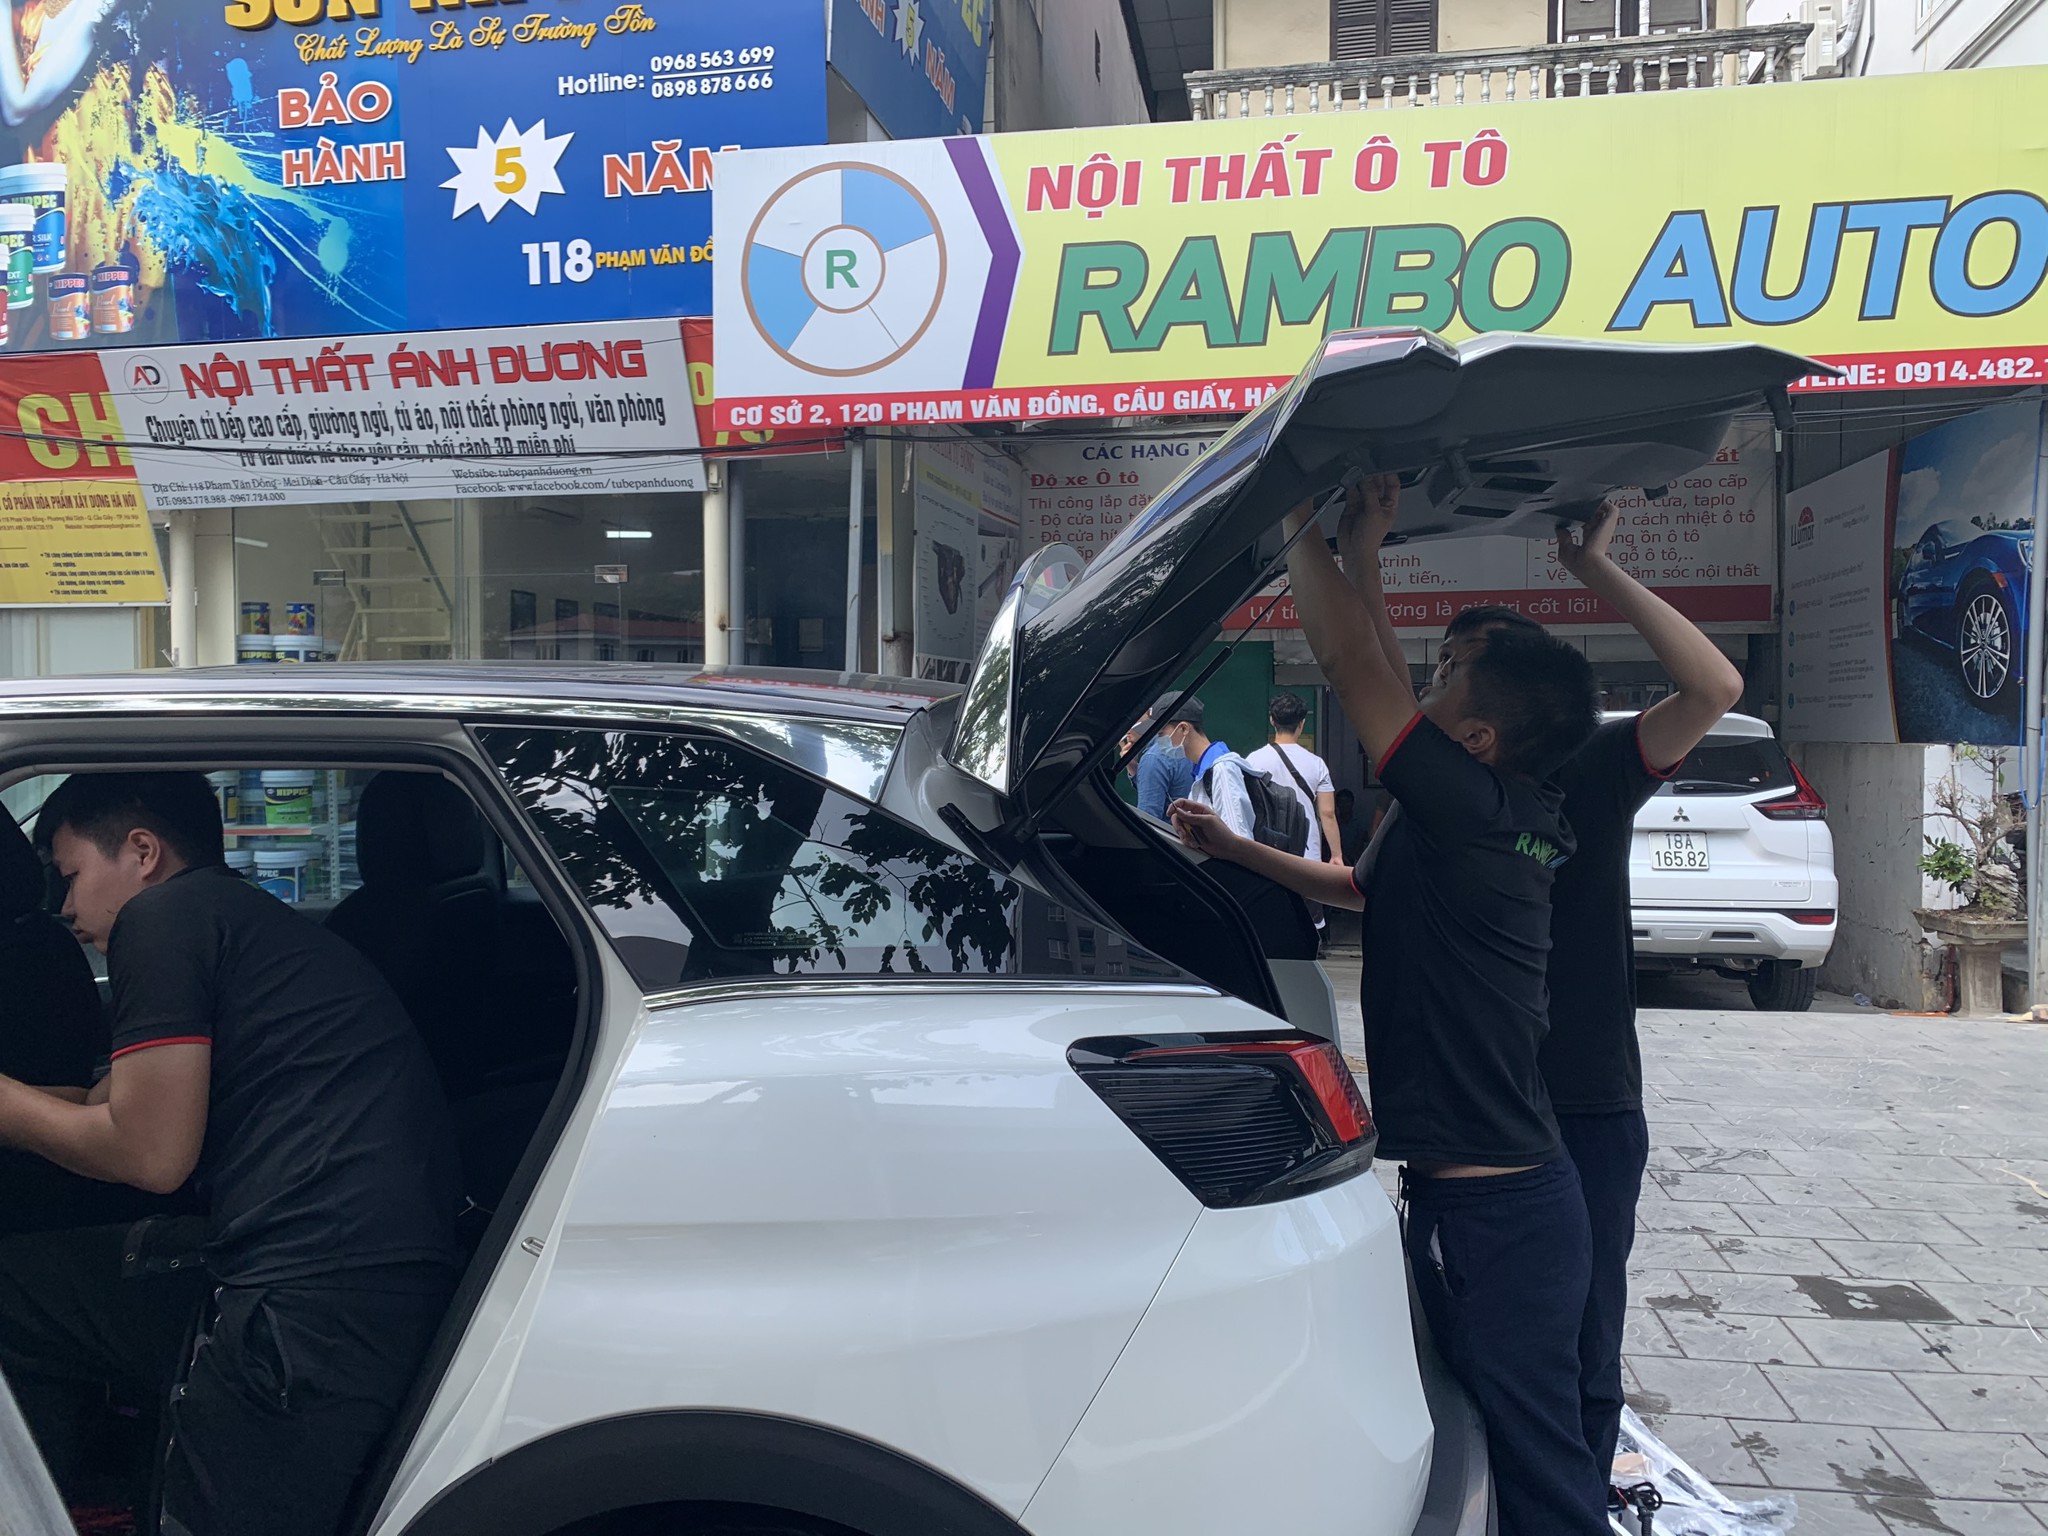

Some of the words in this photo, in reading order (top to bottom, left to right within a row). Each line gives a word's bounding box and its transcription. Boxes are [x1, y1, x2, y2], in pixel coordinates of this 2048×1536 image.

[294, 33, 348, 65] Chất
[355, 27, 423, 64] Lượng
[429, 20, 464, 51] Là
[469, 16, 508, 50] Sự
[512, 12, 598, 49] Trường
[604, 3, 656, 34] Tồn
[905, 3, 915, 48] 5
[650, 53, 696, 73] 0968
[700, 49, 734, 68] 563
[738, 45, 775, 65] 699
[558, 73, 646, 96] Hotline:
[651, 79, 697, 99] 0898
[700, 76, 732, 95] 878
[735, 72, 774, 91] 666
[925, 38, 955, 115] NĂM
[278, 71, 392, 129] BẢO
[281, 136, 405, 187] HÀNH
[493, 147, 527, 194] 5
[1025, 152, 1143, 219] NỘI
[1164, 133, 1331, 205] THẤT
[1353, 134, 1399, 193] Ô
[1422, 127, 1509, 191] TÔ
[522, 238, 595, 286] 118
[596, 250, 646, 271] PHẠM
[650, 244, 686, 265] VĂN
[826, 249, 859, 289] R
[1047, 215, 1573, 357] RAMBO
[1604, 189, 2048, 333] AUTO
[54, 278, 85, 289] NIPPEC
[97, 271, 129, 282] NIPPEC
[180, 353, 254, 406] NỘI
[258, 342, 375, 395] THẤT
[388, 342, 480, 389] ÁNH
[488, 340, 648, 385] DƯƠNG
[731, 404, 763, 426] CƠ
[770, 399, 802, 425] SỞ
[809, 405, 832, 426] 2,
[840, 402, 883, 423] 120
[891, 401, 962, 425] PHẠM
[970, 394, 1021, 419] VĂN
[1027, 389, 1105, 416] ĐỒNG,
[1113, 385, 1164, 413] CẦU
[1173, 382, 1236, 411] GIẤY,
[145, 413, 202, 446] Chuyên
[200, 410, 219, 440] tủ
[217, 407, 247, 444] bếp
[249, 417, 275, 438] cao
[276, 404, 308, 441] cấp,
[308, 407, 360, 441] giường
[360, 402, 395, 437] ngủ,
[395, 401, 412, 432] tủ
[414, 402, 439, 434] áo,
[440, 398, 466, 435] nội
[466, 394, 499, 429] thất
[500, 394, 549, 432] phòng
[549, 393, 584, 429] ngủ,
[586, 394, 616, 424] văn
[616, 392, 667, 428] phòng
[494, 437, 514, 455] 3D
[517, 431, 551, 455] miễn
[554, 434, 577, 458] phí
[1082, 442, 1123, 461] CÁC
[1131, 442, 1189, 461] HẠNG
[1030, 473, 1057, 488] Độ
[1066, 475, 1088, 486] xe
[1096, 468, 1111, 485] Ô
[1119, 470, 1139, 484] tô
[1684, 478, 1712, 489] cao
[1719, 473, 1747, 495] cấp
[1028, 498, 1052, 509] Thi
[1058, 496, 1093, 511] công
[1100, 494, 1122, 509] lắp
[1695, 494, 1735, 511] taplo
[1041, 514, 1061, 528] Độ
[1067, 513, 1094, 525] cửa
[1100, 512, 1122, 524] lùa
[1632, 513, 1669, 526] cách
[1676, 512, 1717, 528] nhiệt
[1723, 511, 1733, 523] ô
[1739, 510, 1756, 523] tô
[1067, 530, 1094, 542] cửa
[1667, 529, 1678, 543] ô
[1684, 529, 1700, 542] tô
[1383, 555, 1421, 567] trình
[1619, 546, 1639, 564] gỗ
[1645, 548, 1655, 561] ô
[1547, 568, 1567, 583] Vệ
[1663, 566, 1690, 579] sóc
[1696, 562, 1720, 578] nội
[1727, 560, 1760, 578] thất
[1437, 601, 1452, 616] là
[1528, 598, 1560, 613] cốt
[1568, 598, 1599, 613] lõi!
[1665, 833, 1694, 850] 18A
[1655, 850, 1707, 867] 165.82
